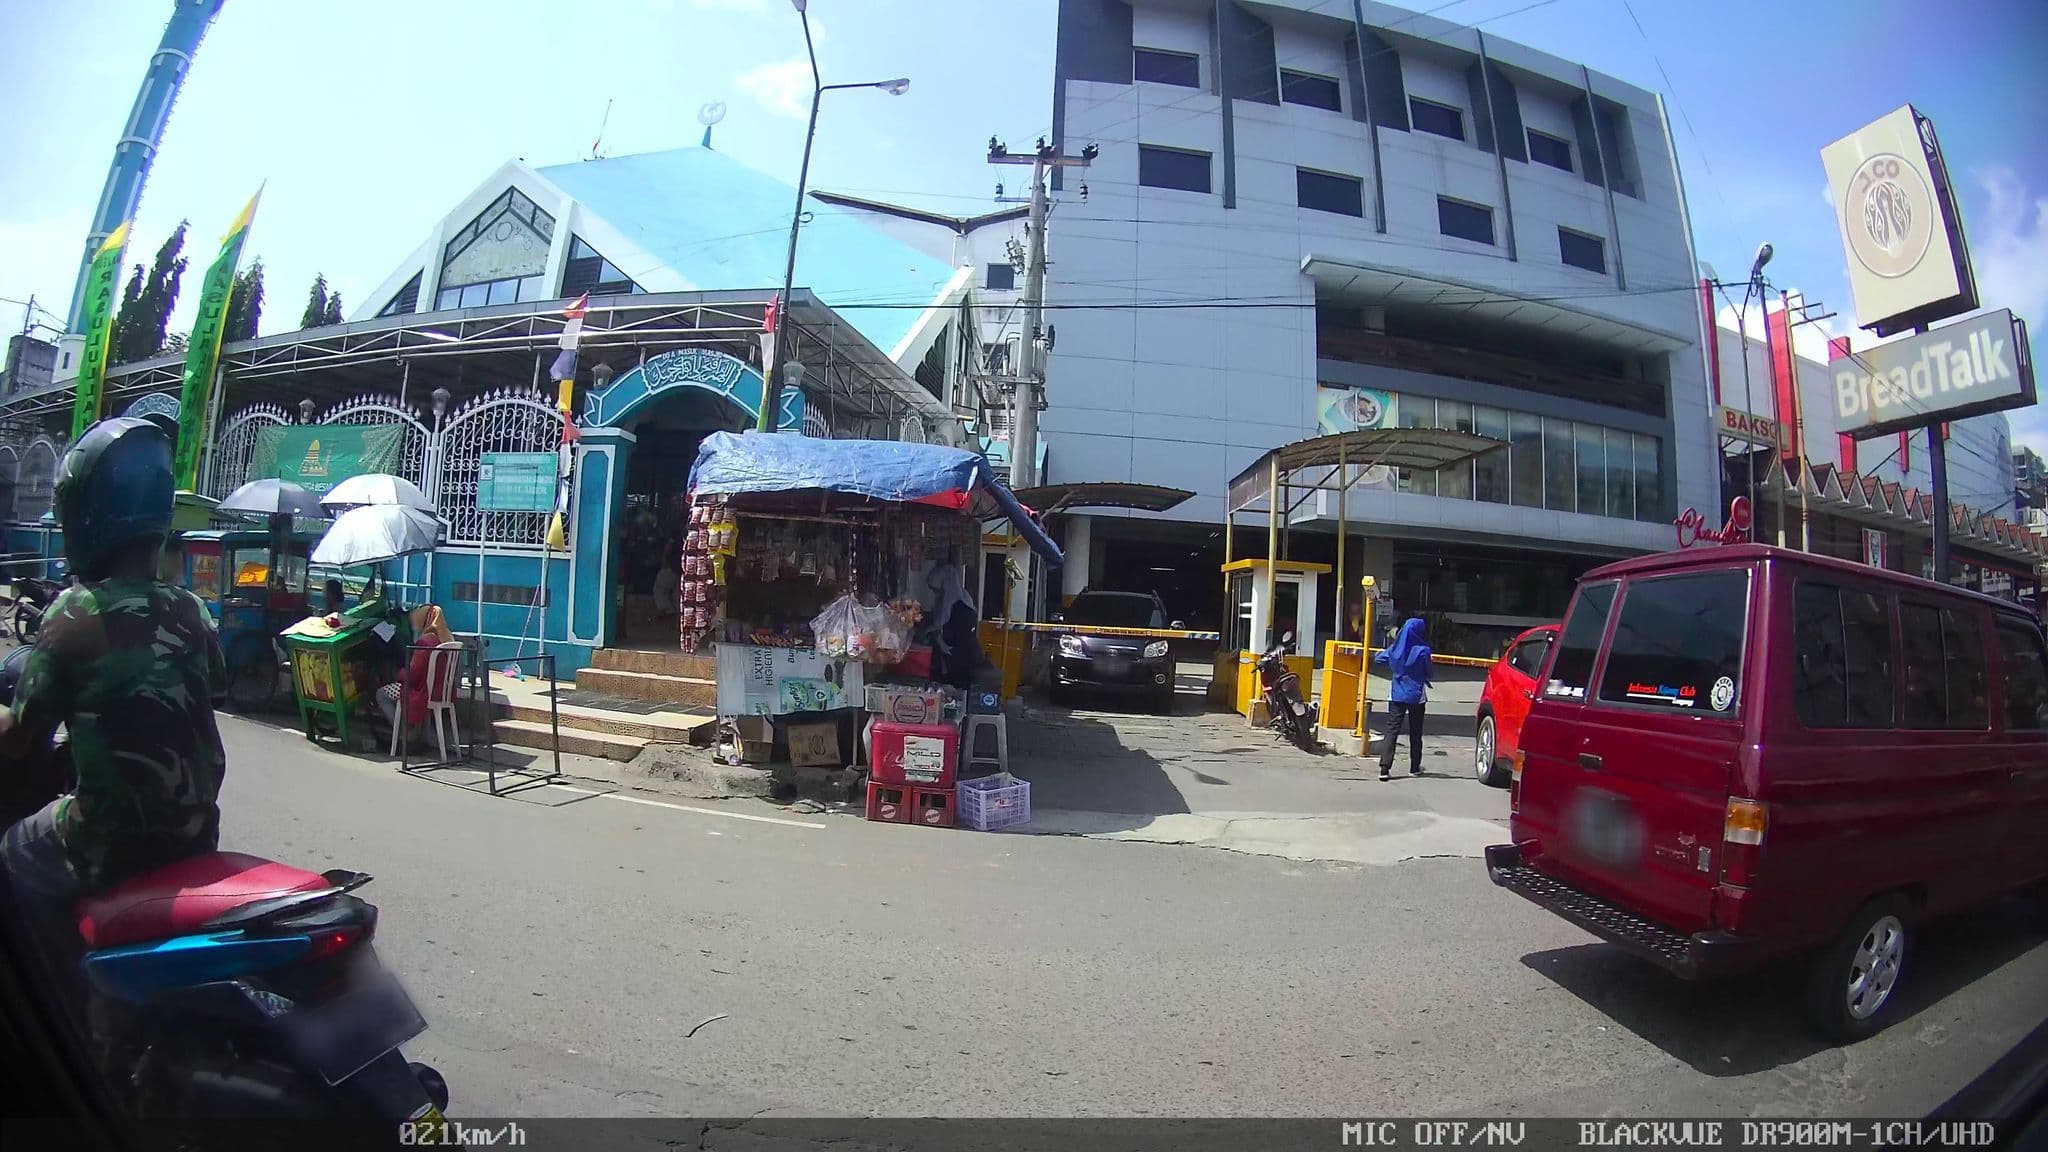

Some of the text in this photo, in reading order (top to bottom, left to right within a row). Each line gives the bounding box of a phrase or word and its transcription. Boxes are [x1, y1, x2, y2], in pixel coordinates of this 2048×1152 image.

[1857, 159, 1900, 194] J.CO
[1836, 328, 2011, 418] BreadTalk
[1680, 685, 1697, 697] Club
